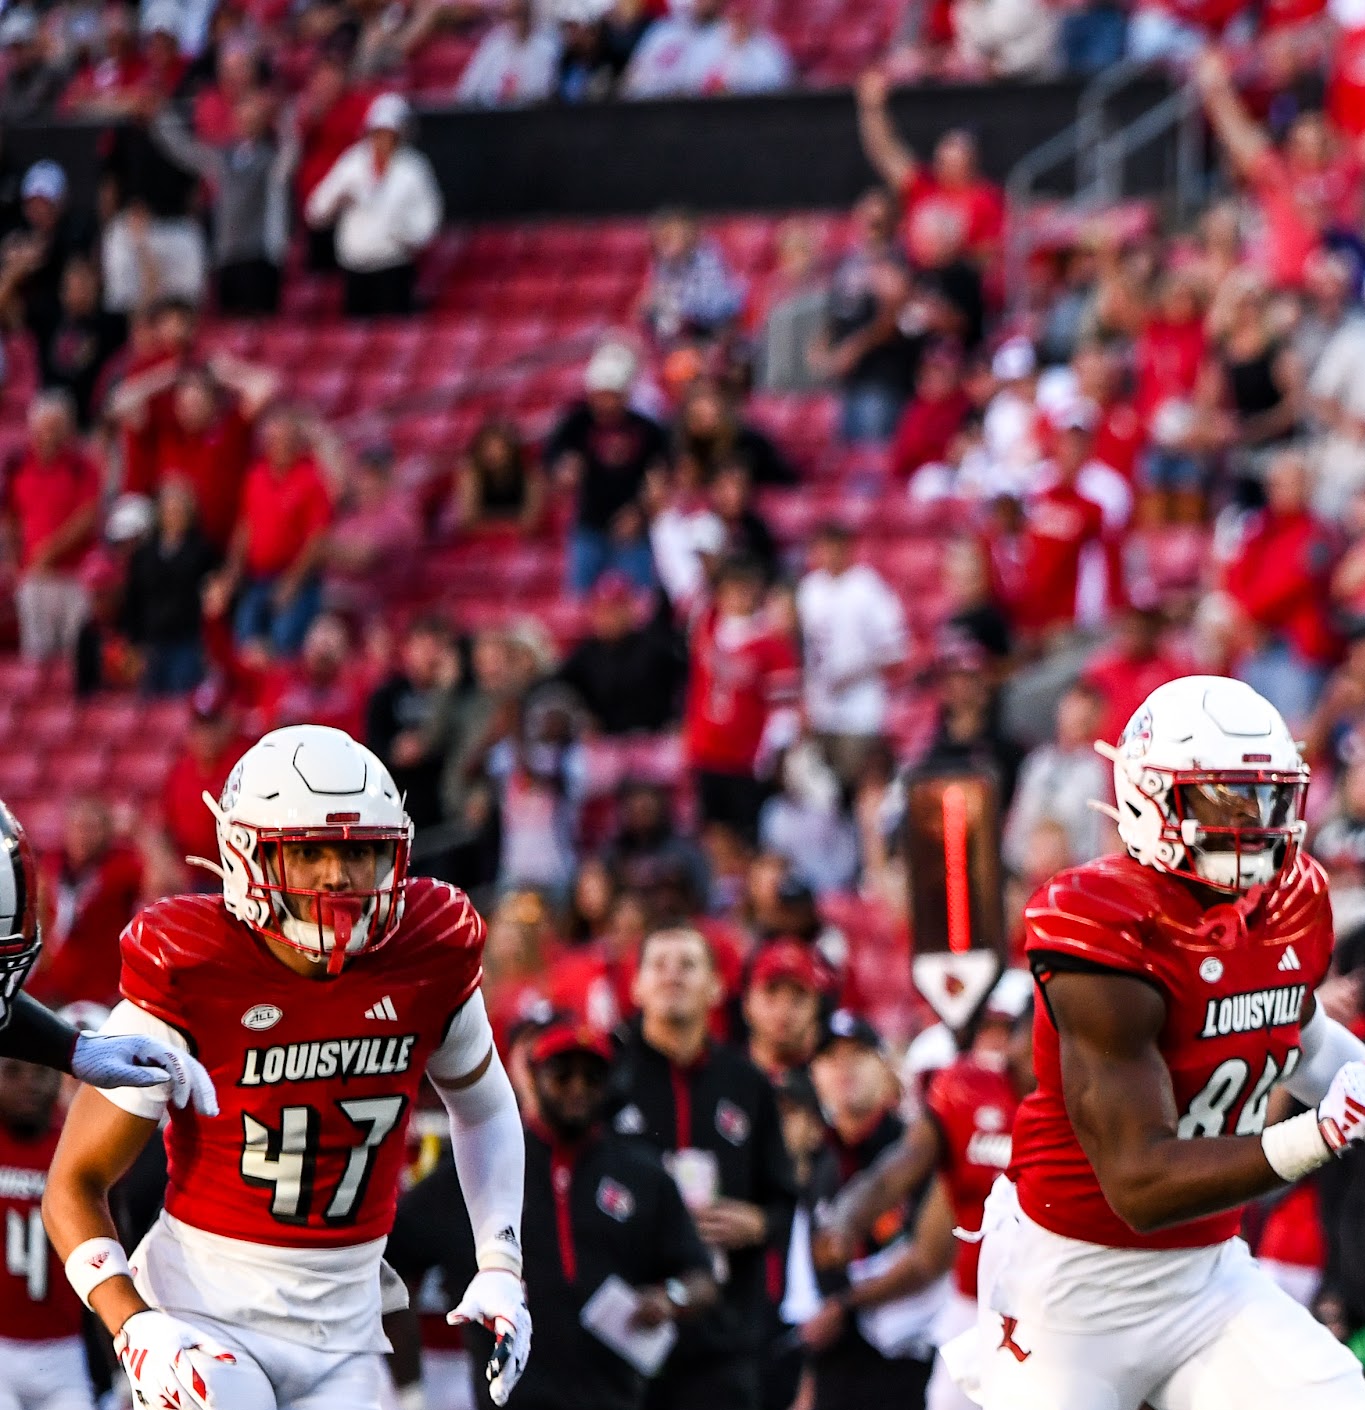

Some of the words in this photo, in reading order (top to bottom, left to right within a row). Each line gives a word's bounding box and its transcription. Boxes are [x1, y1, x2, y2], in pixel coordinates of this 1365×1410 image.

[240, 1035, 416, 1086] LOUISVILLE
[1177, 1047, 1301, 1140] 84
[240, 1095, 404, 1219] 47
[5, 1204, 48, 1301] 4
